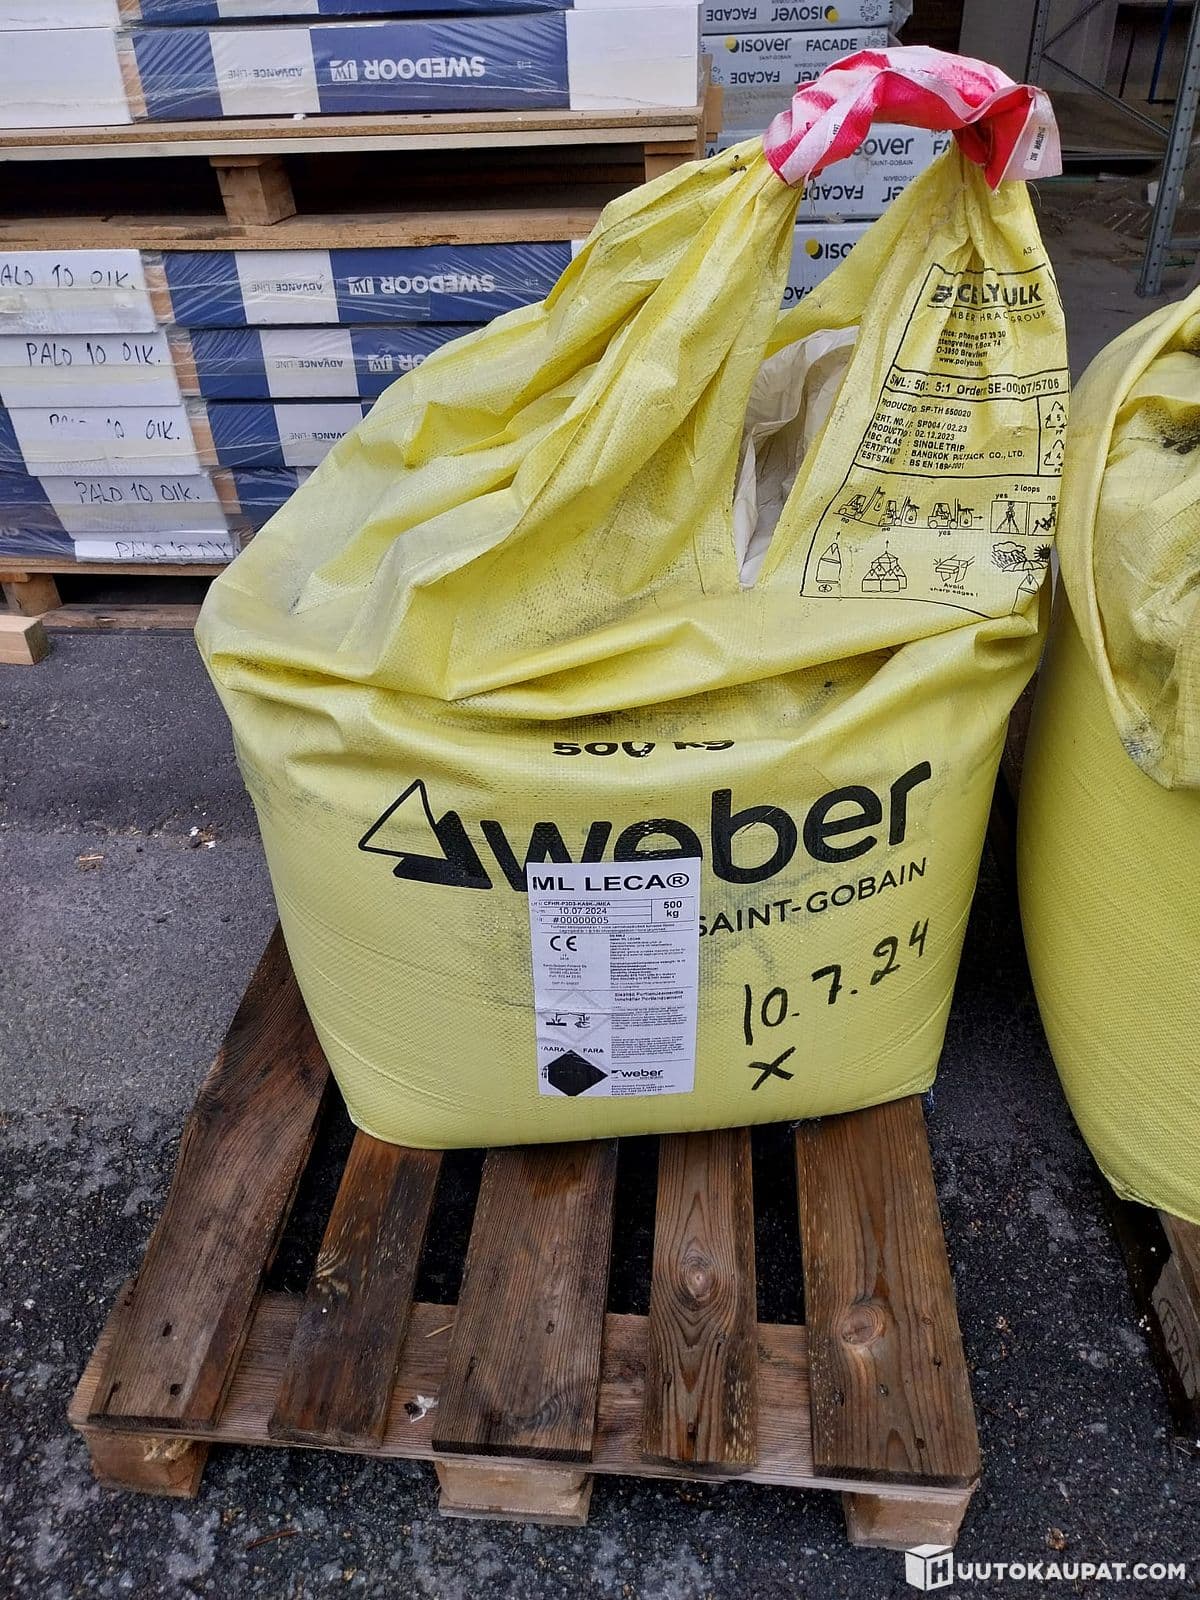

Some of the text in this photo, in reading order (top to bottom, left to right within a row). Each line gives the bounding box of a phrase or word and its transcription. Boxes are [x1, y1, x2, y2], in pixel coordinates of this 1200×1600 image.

[706, 7, 758, 21] FACADE
[806, 38, 858, 52] FACADE
[363, 56, 486, 80] SWEDOOR
[730, 71, 780, 84] FACADE
[0, 264, 33, 286] ALO
[380, 274, 496, 295] SWEDOOR
[915, 429, 955, 441] 02.12.2023
[946, 443, 966, 452] TRIP
[911, 449, 949, 460] BANGKOK
[1021, 484, 1041, 494] loops
[995, 492, 1009, 500] yes
[479, 760, 932, 893] weber
[532, 876, 575, 891] ML
[698, 857, 928, 938] SAINT-GOBAIN
[663, 900, 683, 909] 500
[666, 909, 680, 919] kg
[621, 1069, 664, 1078] weber
